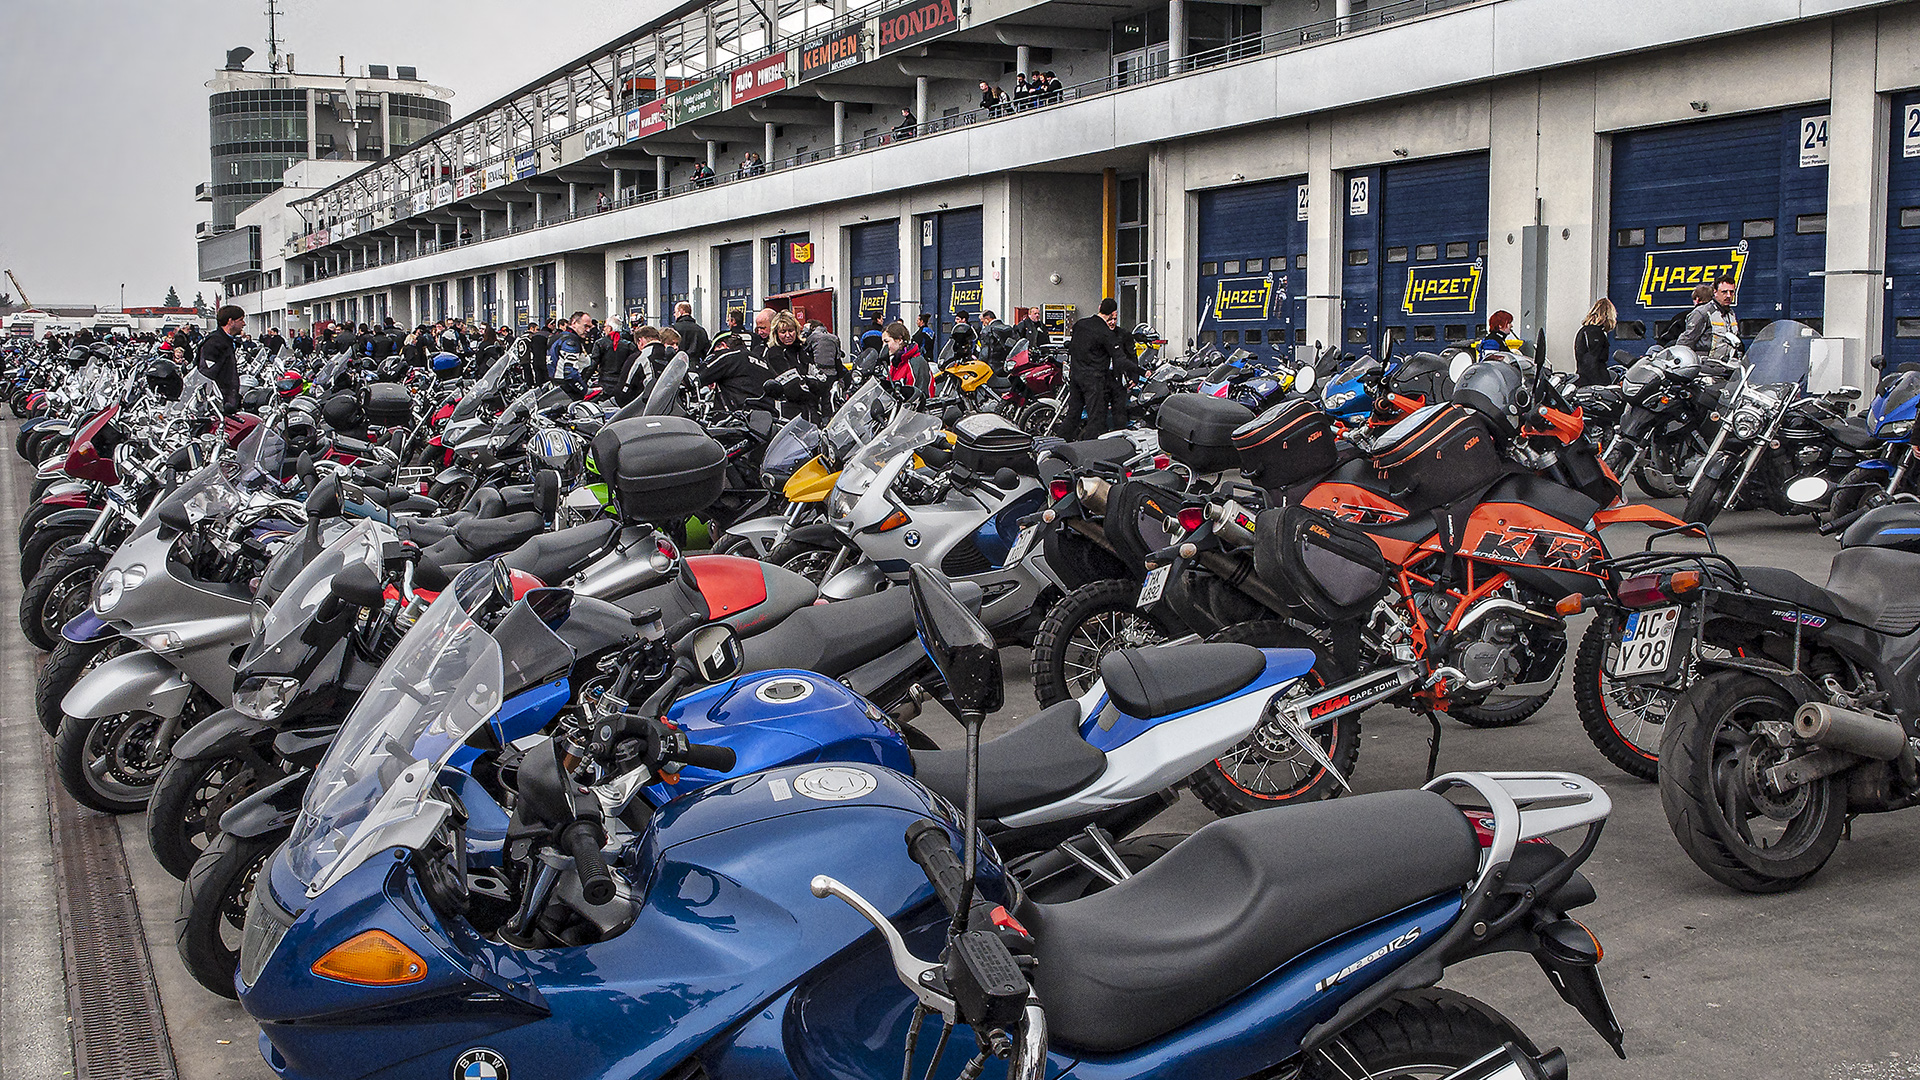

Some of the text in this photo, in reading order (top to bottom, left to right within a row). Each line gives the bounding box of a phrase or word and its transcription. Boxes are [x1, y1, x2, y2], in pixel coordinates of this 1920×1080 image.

[880, 0, 956, 46] HONDA
[803, 34, 857, 71] KEMPEN
[584, 127, 607, 152] OPEL
[1804, 120, 1828, 149] 24
[1352, 181, 1366, 203] 23
[925, 222, 931, 237] 21
[1411, 277, 1472, 301] HAZET
[1649, 264, 1733, 292] HAZET
[862, 296, 884, 311] HAZET
[953, 289, 981, 306] HAZET
[1220, 289, 1266, 309] HAZET
[1634, 612, 1664, 641] AC
[1622, 639, 1667, 671] Y 98
[1310, 677, 1400, 719] KTM CAPE TOWN
[459, 1052, 503, 1069] BMW
